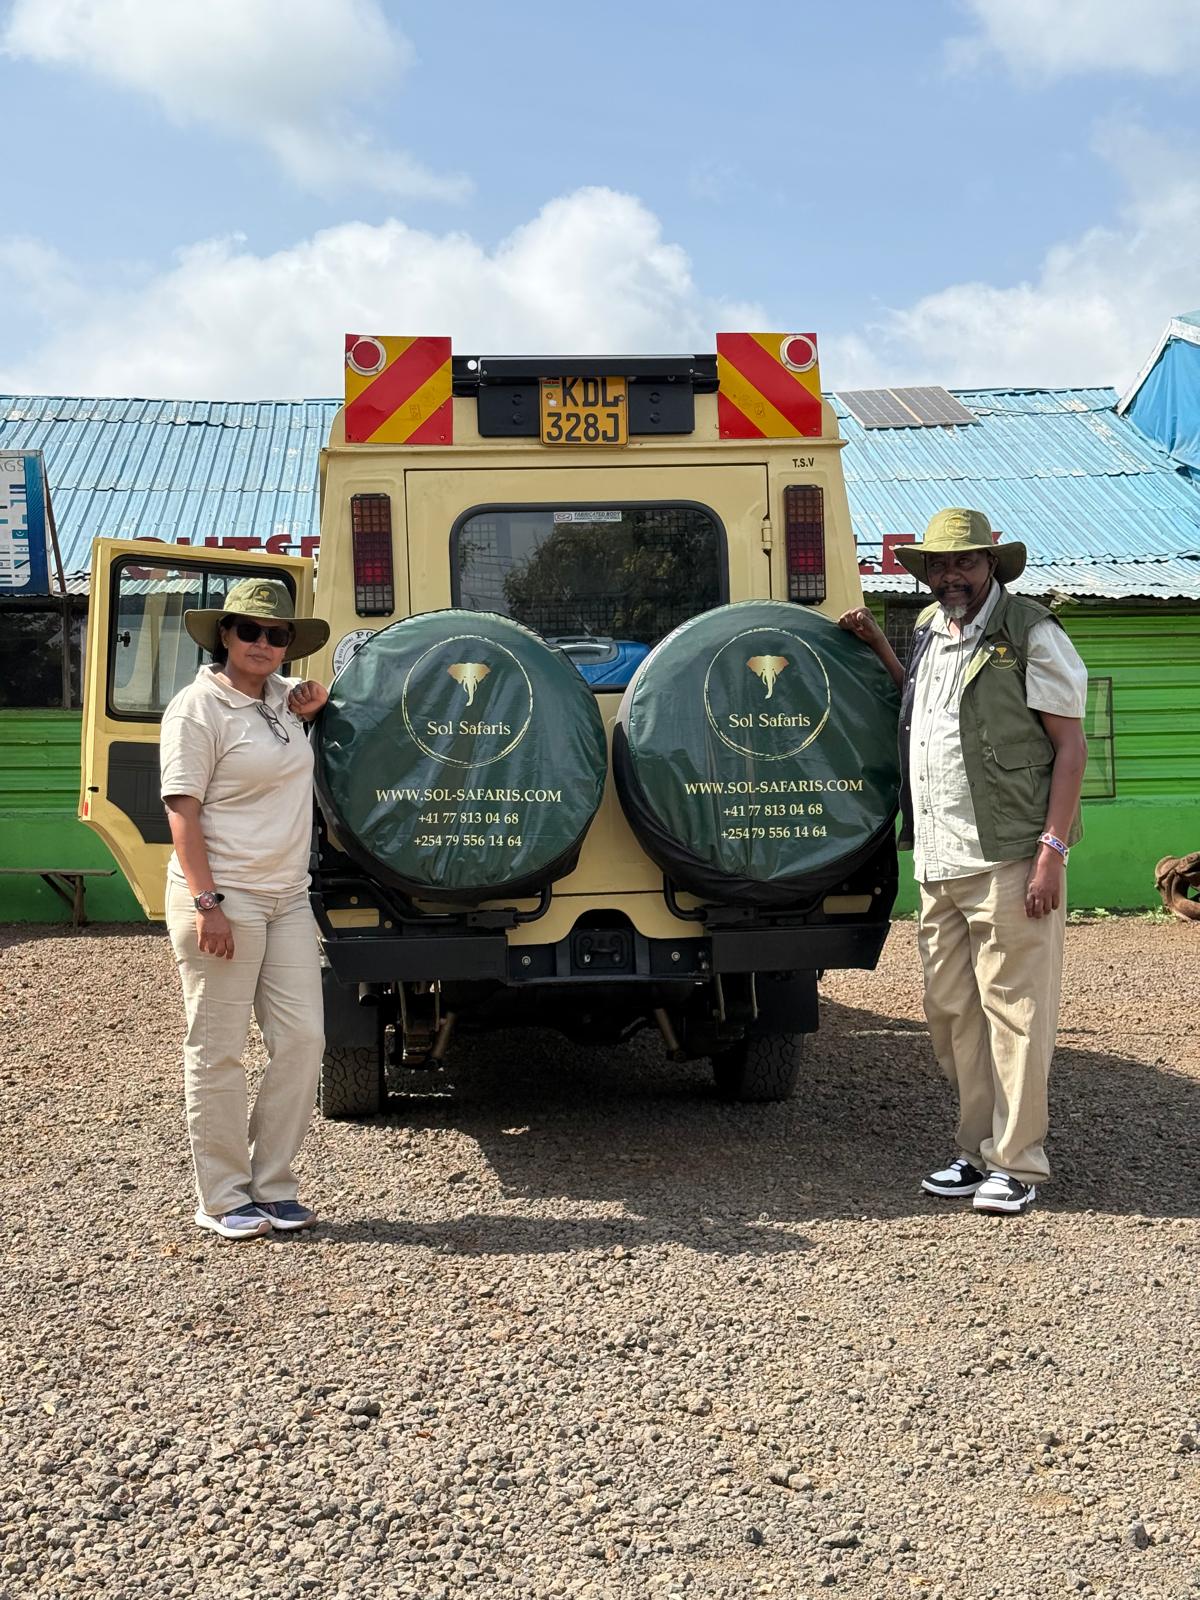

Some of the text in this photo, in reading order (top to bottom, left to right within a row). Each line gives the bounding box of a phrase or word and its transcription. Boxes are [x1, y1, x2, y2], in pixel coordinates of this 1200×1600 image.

[562, 377, 620, 408] KDL
[546, 412, 620, 442] 328J
[792, 457, 814, 468] T.S.V
[427, 720, 511, 735] Sol Safaris
[728, 713, 811, 728] Sol Safaris
[684, 779, 864, 795] WWW.SOL-SAFARIS.COM
[375, 788, 562, 803] WWW.SOL-SAFARIS.COM
[723, 803, 823, 817] +41 77 813 04 68
[418, 812, 519, 824] +41 77 813 04 68
[721, 825, 828, 840] +254 79 556 14 64
[414, 834, 522, 847] +254 79 556 14 64
